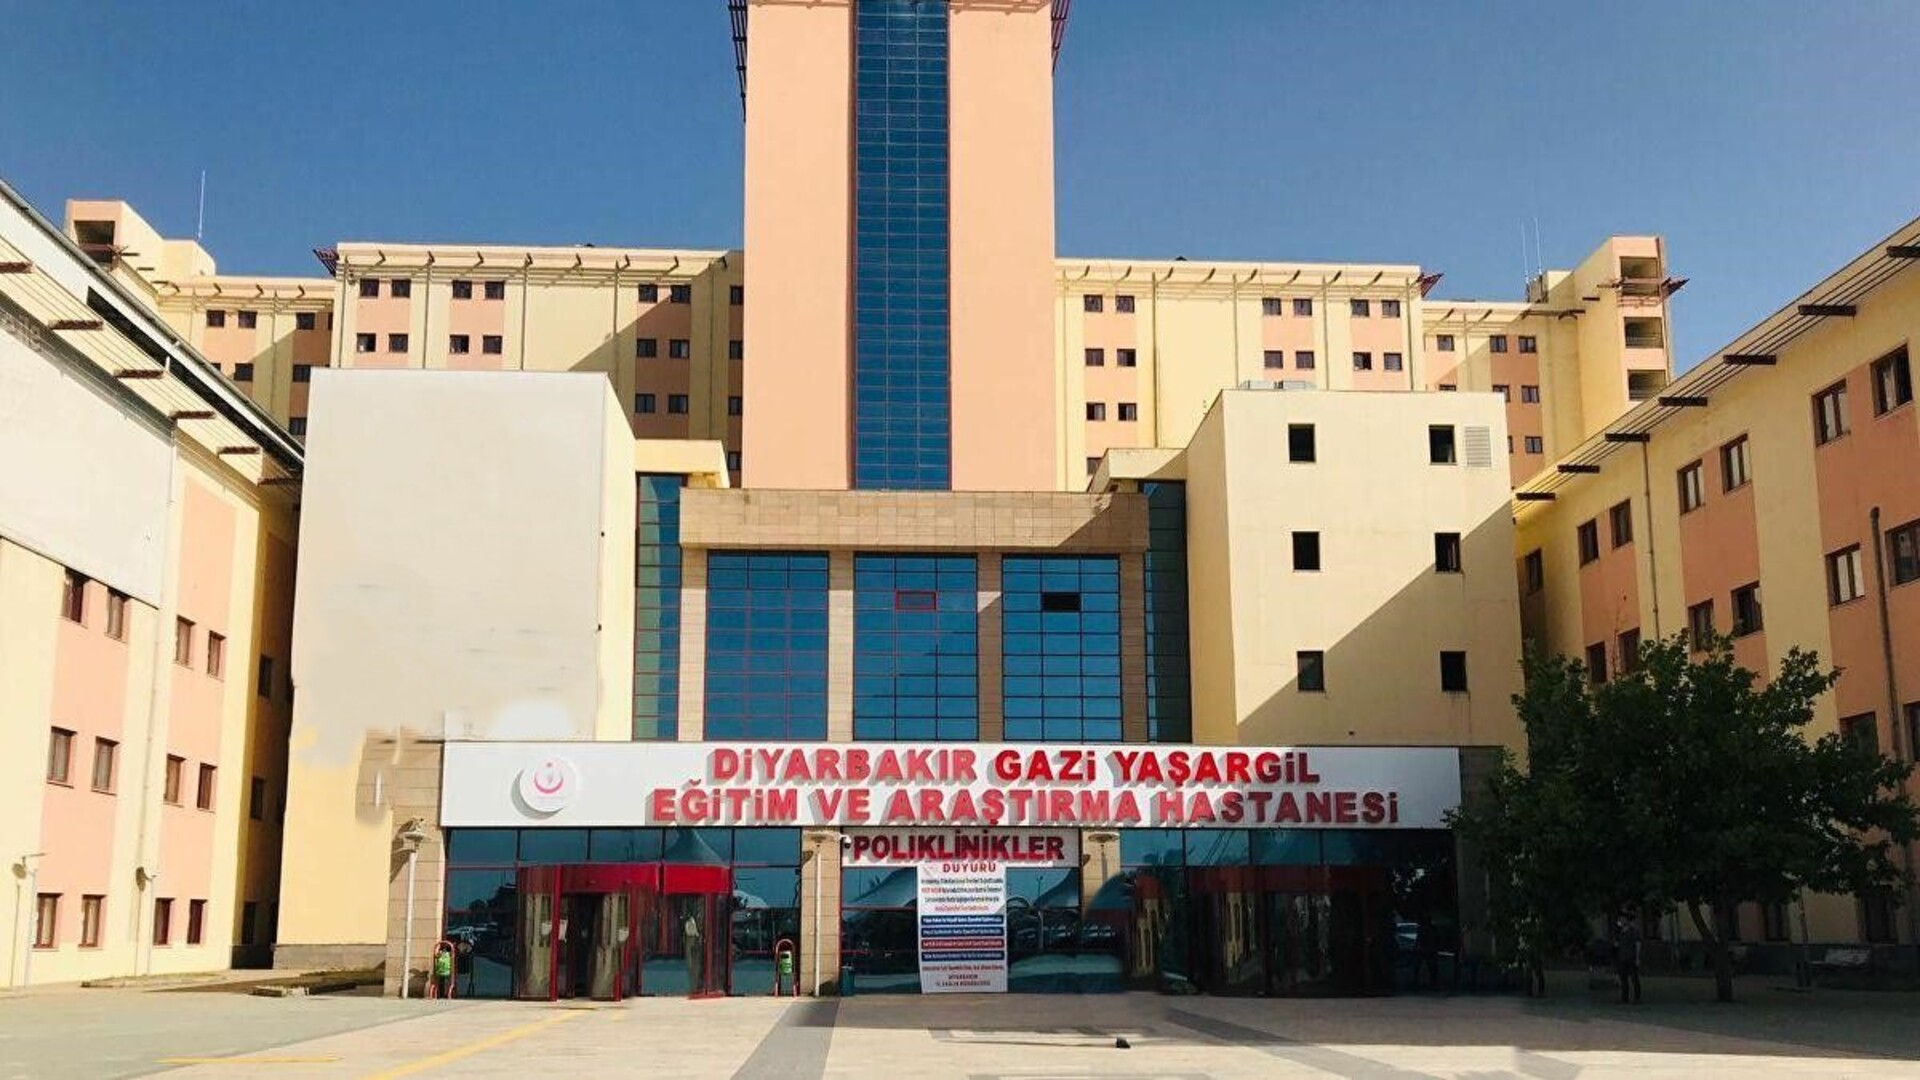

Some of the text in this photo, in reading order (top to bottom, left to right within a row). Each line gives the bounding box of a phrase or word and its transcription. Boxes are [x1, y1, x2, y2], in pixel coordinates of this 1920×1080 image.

[816, 788, 870, 822] VE
[886, 788, 1141, 826] ARAŞTIRMA
[943, 863, 996, 873] DUYURU
